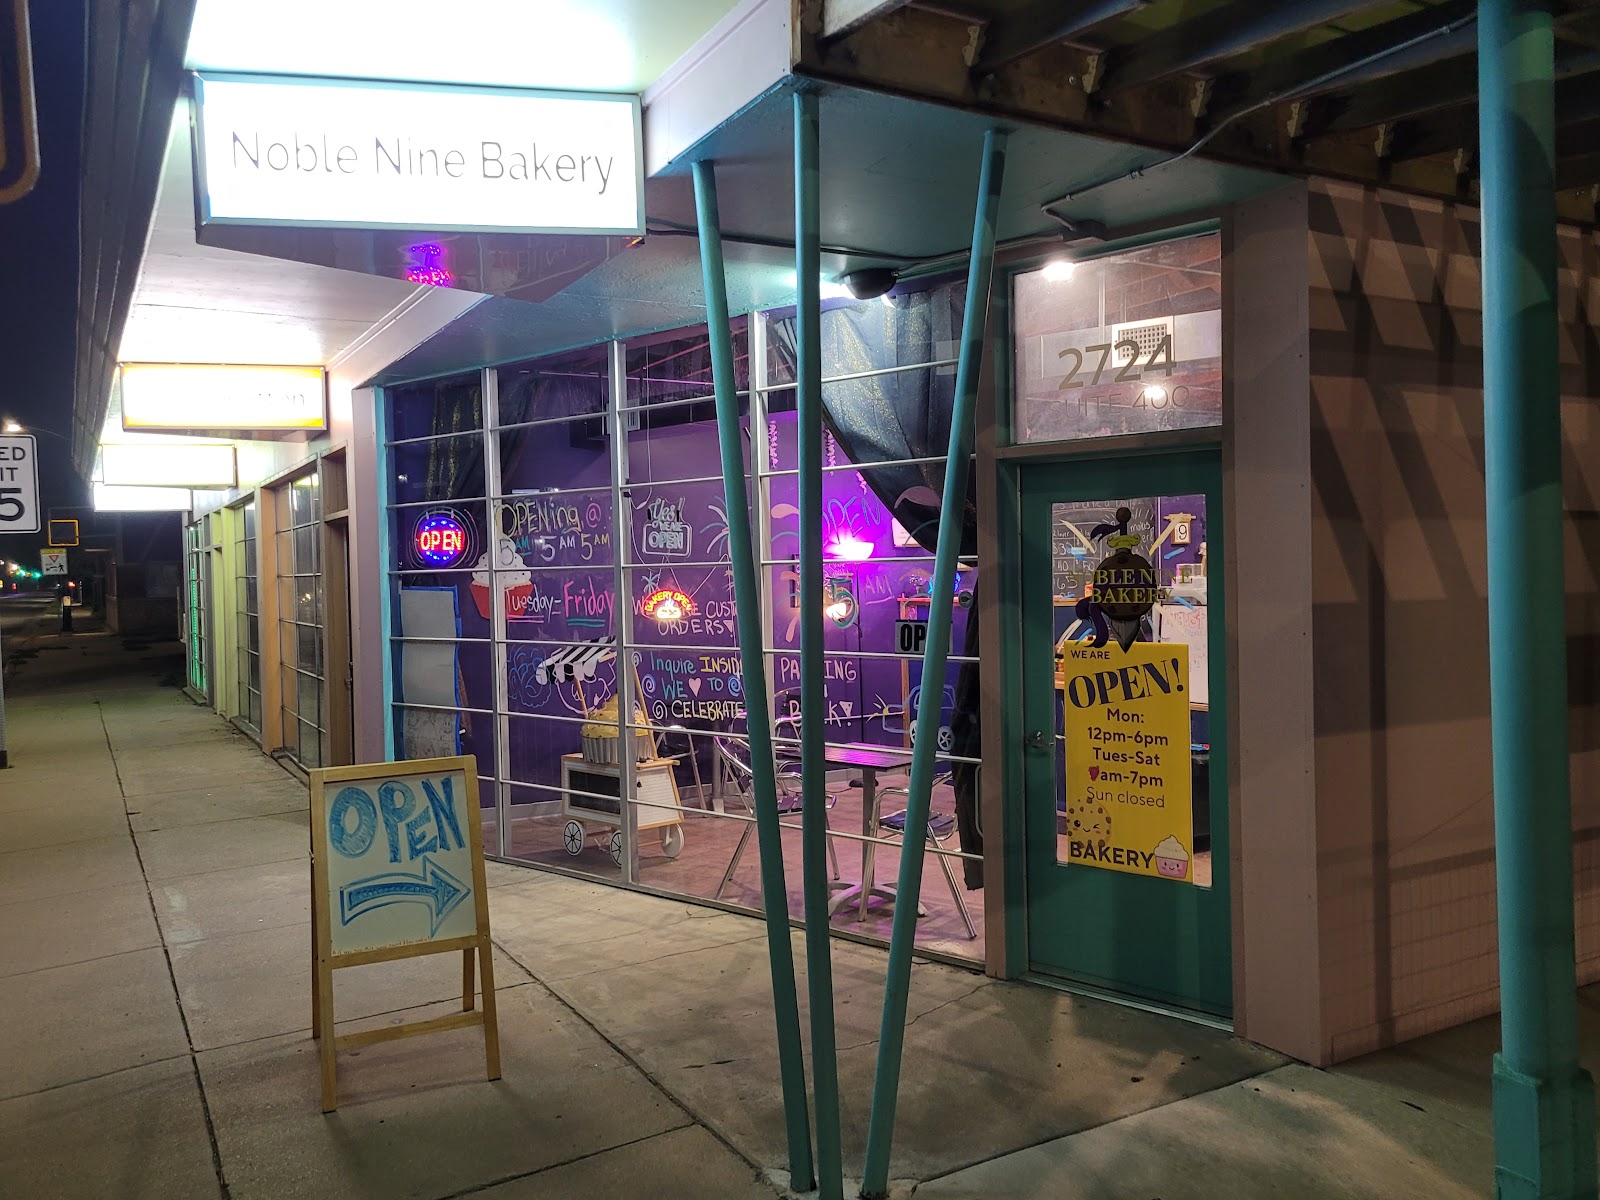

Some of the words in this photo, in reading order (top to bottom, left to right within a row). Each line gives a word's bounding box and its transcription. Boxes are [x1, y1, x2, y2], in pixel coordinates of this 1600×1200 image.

[231, 131, 358, 174] Noble
[375, 136, 465, 178] Nine
[481, 141, 613, 195] Bakery
[1058, 334, 1177, 390] 2724
[1050, 393, 1122, 421] SUITE
[420, 530, 462, 551] OPEN
[648, 531, 683, 549] OPEN
[1178, 525, 1188, 540] 9
[559, 535, 576, 550] AM
[580, 533, 593, 560] 5
[594, 533, 611, 549] AM
[864, 574, 893, 596] AM
[1068, 569, 1134, 585] NOBLE
[645, 590, 673, 612] BAKERY
[673, 593, 693, 611] OPEN
[1090, 587, 1174, 604] BAKERY
[706, 600, 737, 618] CUST
[650, 651, 696, 680] Inquire
[1071, 650, 1087, 658] WE
[1089, 651, 1110, 659] ARE
[780, 657, 857, 682] PAING
[662, 678, 688, 699] WE
[707, 677, 723, 692] TO
[1068, 658, 1184, 708] OPEN!
[671, 700, 747, 720] CELEBRATE
[1107, 708, 1144, 723] Mon:
[1088, 727, 1168, 747] 12pm-6pm
[1092, 747, 1160, 766] Tues-Sat
[1088, 766, 1163, 788] am-7pm
[1086, 786, 1113, 801] Sun
[1117, 791, 1165, 808] closed
[329, 775, 465, 863] OPEN
[1070, 841, 1155, 869] BAKERY
